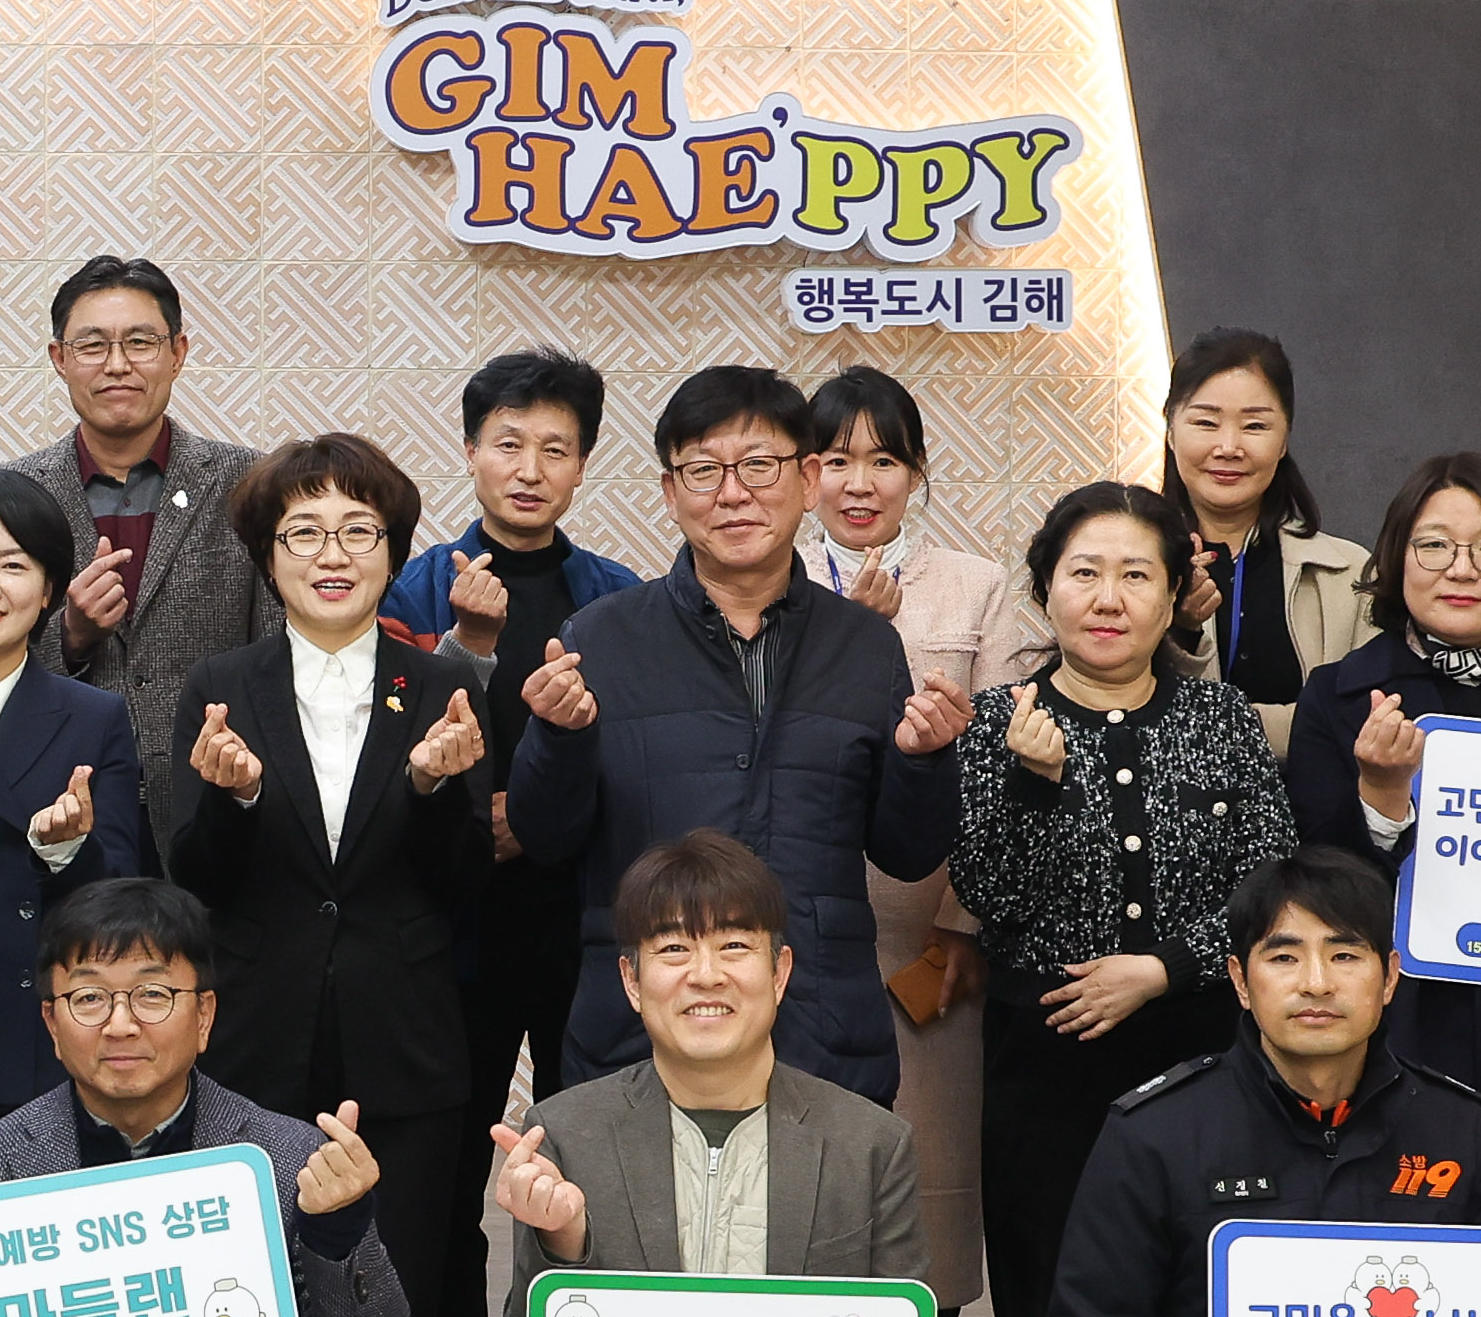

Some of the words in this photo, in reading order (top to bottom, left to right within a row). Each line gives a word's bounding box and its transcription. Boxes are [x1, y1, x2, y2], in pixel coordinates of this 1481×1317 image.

[386, 22, 677, 140] GIM
[464, 106, 1069, 244] HAE'PPY
[794, 276, 963, 325] 행복도시
[982, 276, 1066, 325] 김해
[1390, 1160, 1461, 1198] 119
[1399, 1154, 1428, 1169] 소방
[77, 1210, 147, 1254] SNS
[161, 1195, 231, 1239] 상담
